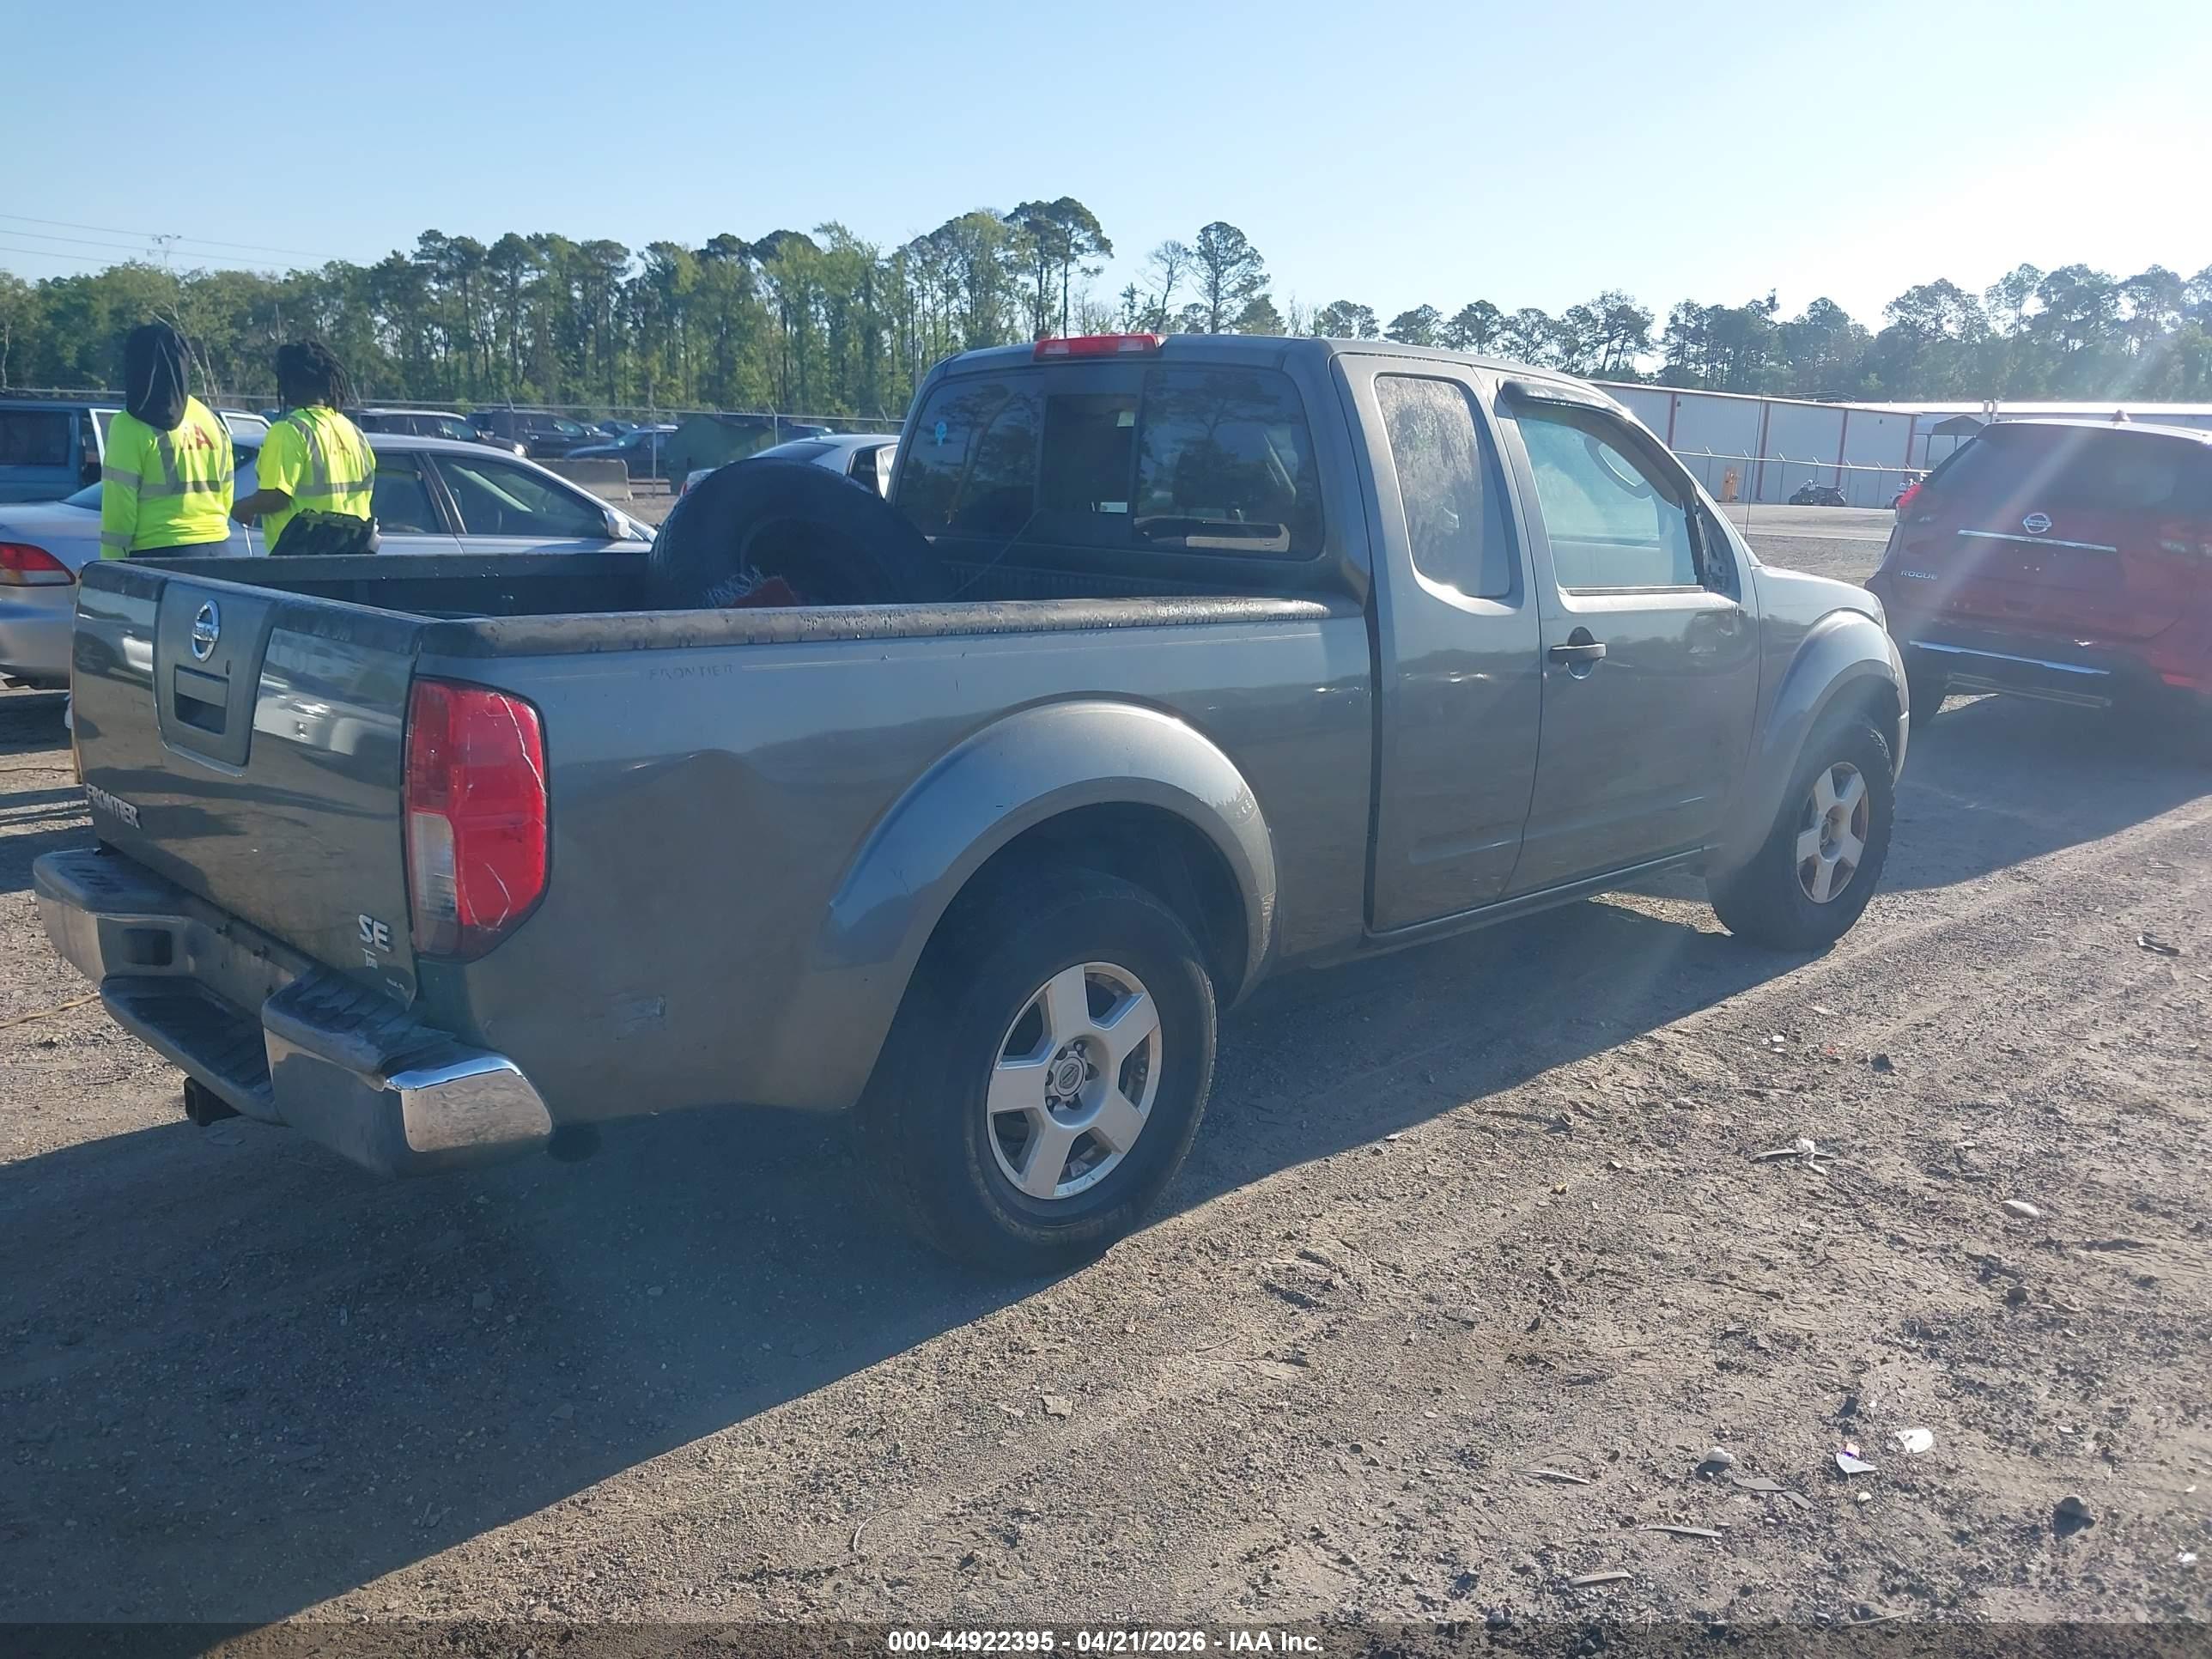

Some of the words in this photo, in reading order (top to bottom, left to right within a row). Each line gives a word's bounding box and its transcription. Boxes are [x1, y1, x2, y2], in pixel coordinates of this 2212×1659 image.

[1899, 569, 1938, 580] ROGUE
[86, 782, 141, 830] FRONTIER
[358, 914, 391, 952] SE
